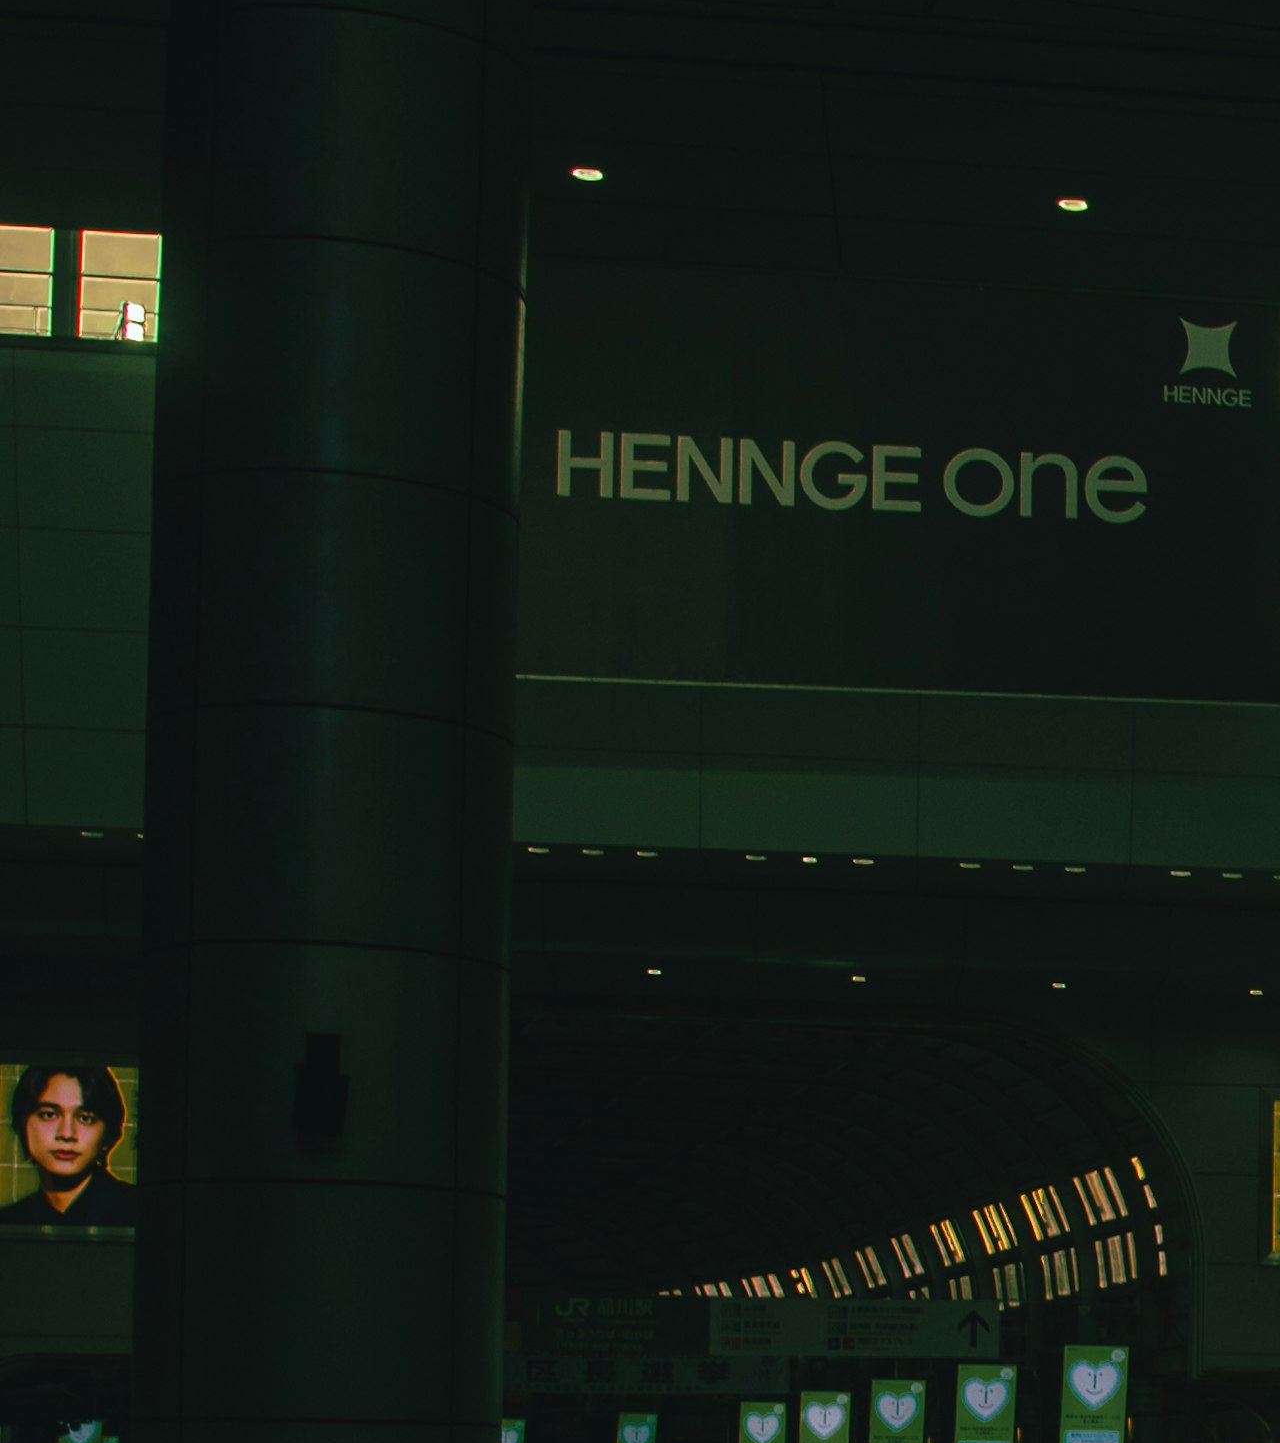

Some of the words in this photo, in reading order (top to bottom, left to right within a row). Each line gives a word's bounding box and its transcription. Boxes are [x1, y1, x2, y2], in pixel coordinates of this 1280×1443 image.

[1163, 384, 1252, 408] HENNGE
[556, 429, 922, 513] HENNGE
[942, 446, 1148, 524] one
